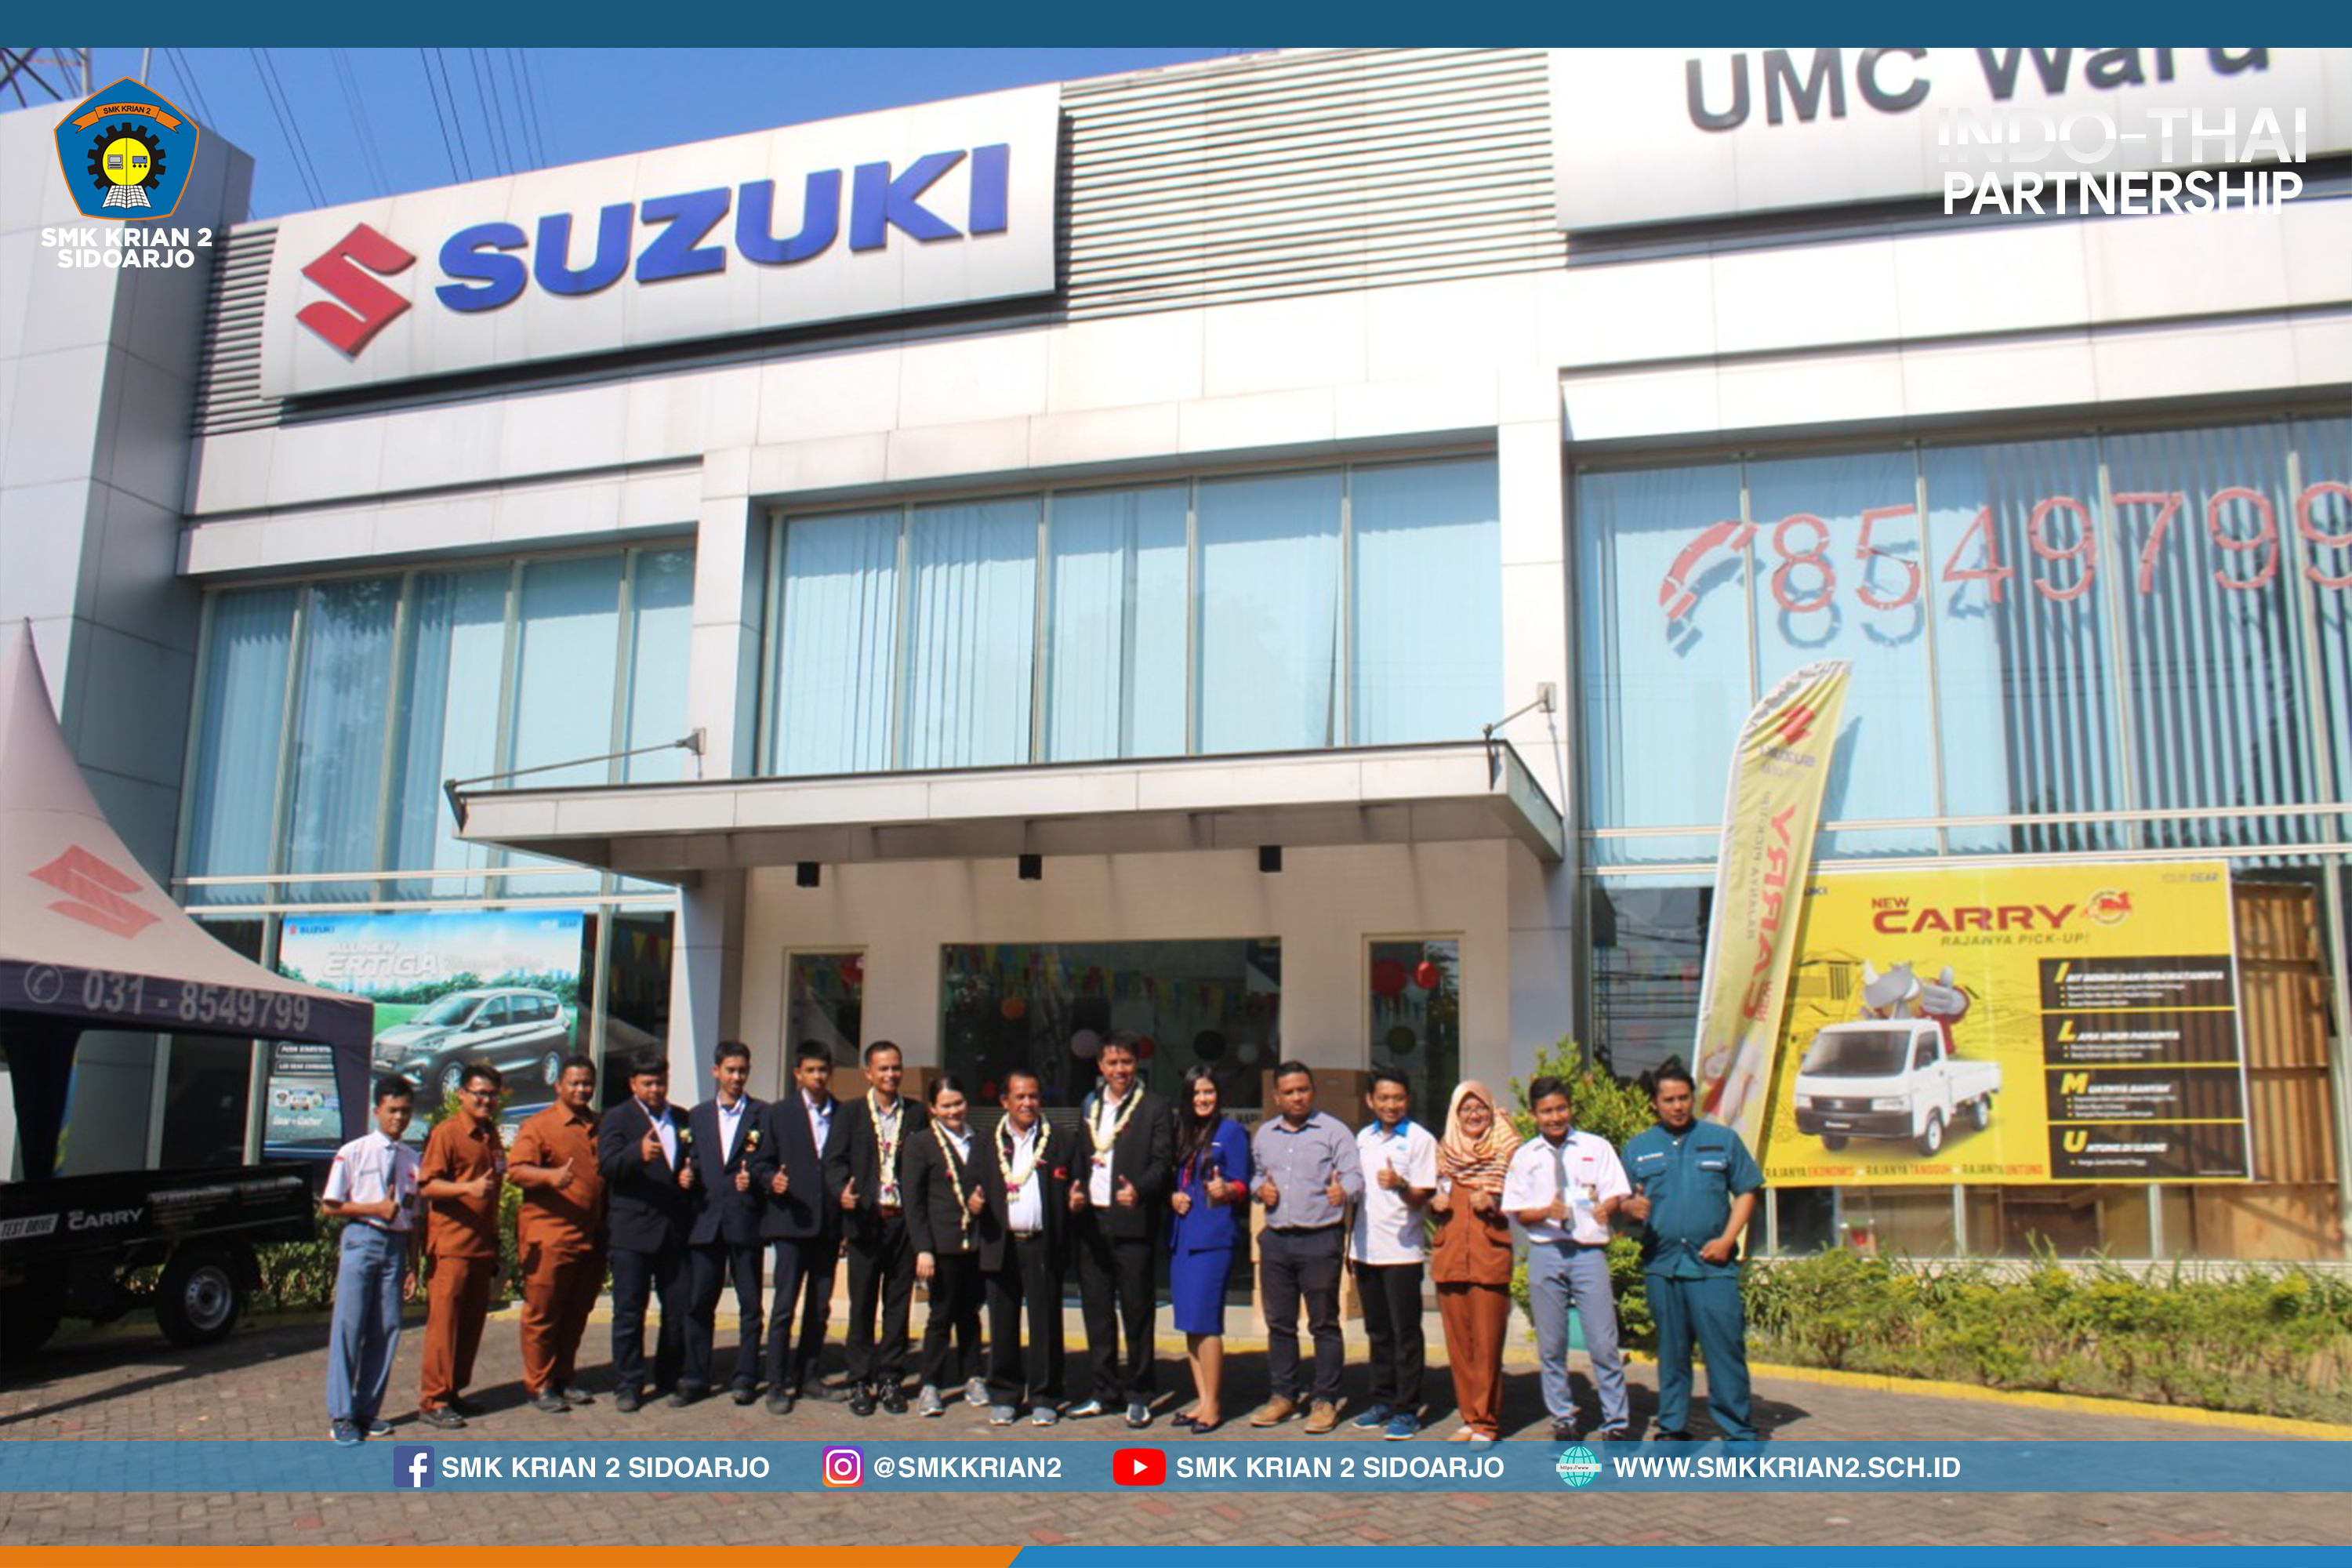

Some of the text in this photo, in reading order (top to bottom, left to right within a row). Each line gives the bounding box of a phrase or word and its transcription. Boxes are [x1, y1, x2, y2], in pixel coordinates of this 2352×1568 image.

[1685, 47, 1932, 133] UMC
[434, 143, 1011, 315] SUZUKI
[1871, 897, 1910, 909] NEW
[1872, 904, 2077, 935] CARRY
[1940, 932, 2090, 948] RAJANYA PICK-UP!
[321, 952, 440, 978] ERTIGA
[82, 970, 145, 1014] 031
[179, 981, 310, 1033] 8549799
[2, 1216, 54, 1238] TEST DRIVE
[67, 1207, 143, 1231] CARRY
